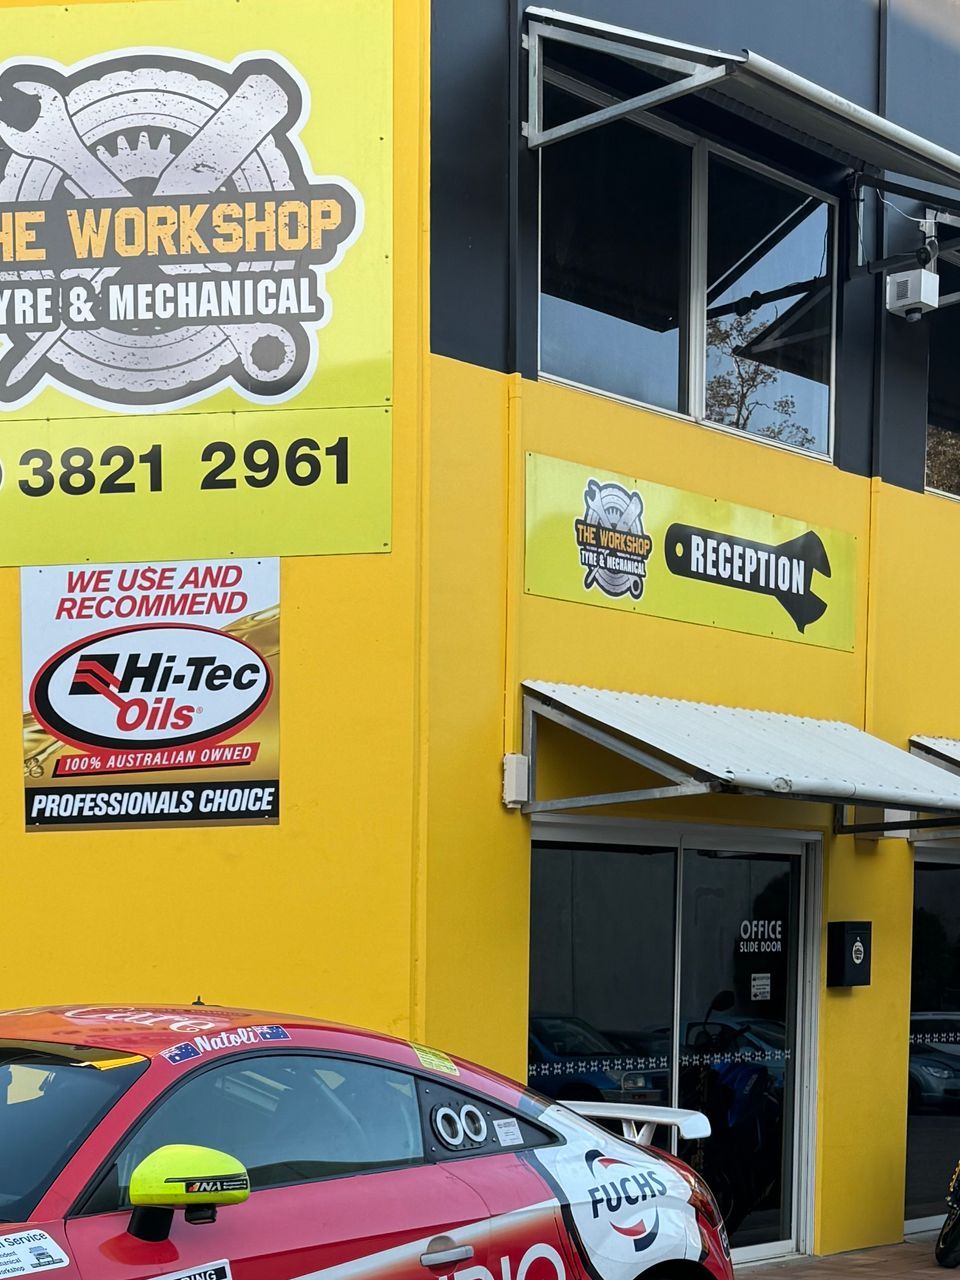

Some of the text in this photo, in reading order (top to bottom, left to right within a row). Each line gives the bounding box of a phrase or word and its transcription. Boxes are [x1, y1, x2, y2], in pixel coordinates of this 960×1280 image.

[67, 199, 342, 258] WORKSHOP
[68, 286, 95, 323] &
[109, 277, 316, 320] MECHANICAL
[17, 437, 349, 497] 3821 2961
[577, 524, 650, 555] THE WORKSHOP
[581, 550, 646, 575] TYRE & MECHANICAL
[691, 534, 805, 595] RECEPTION
[67, 565, 243, 593] WE USE AND
[55, 591, 248, 620] RECOMMEND
[117, 652, 261, 694] Hi-Tec
[116, 697, 195, 732] Oils
[65, 746, 252, 771] 100% AUSTRALIAN OWNED
[31, 787, 275, 818] PROFESSIONALS CHOICE
[740, 920, 782, 939] OFFICE
[740, 941, 759, 952] SLIDE
[194, 1028, 259, 1053] Natoli
[587, 1170, 668, 1219] FUCHS
[3, 1231, 48, 1248] Service
